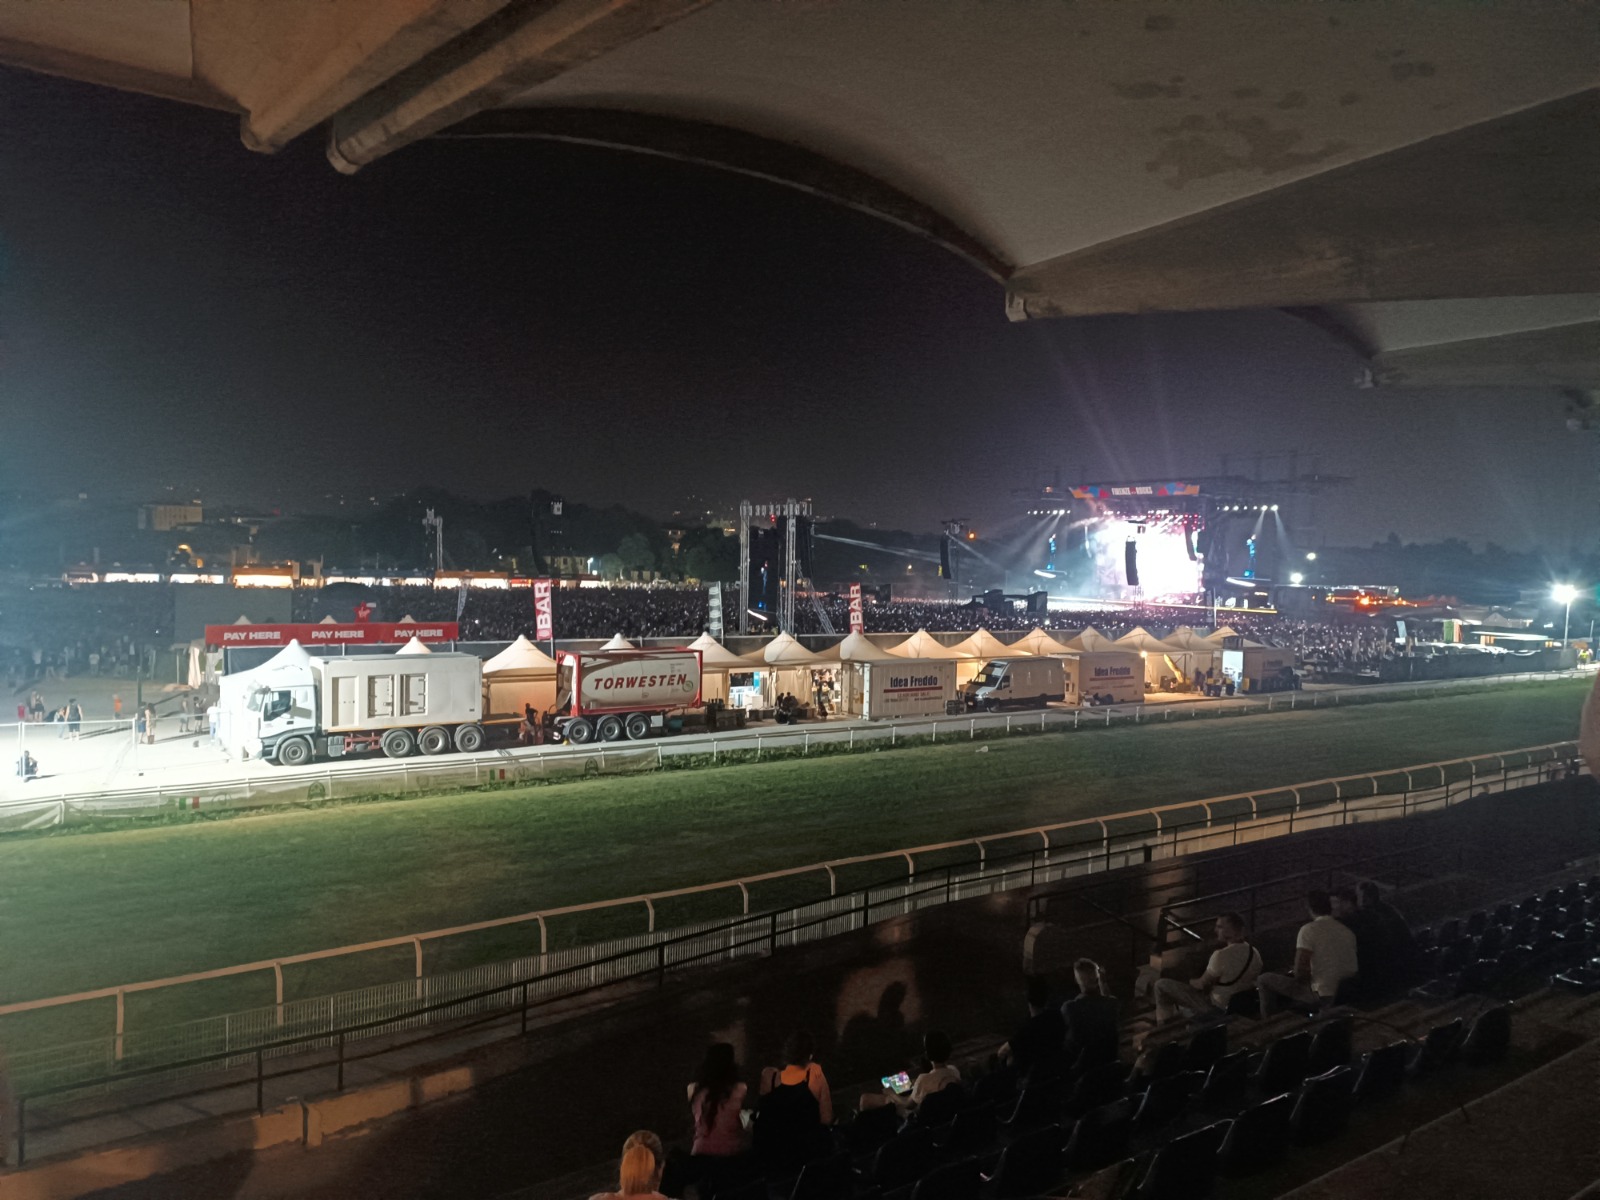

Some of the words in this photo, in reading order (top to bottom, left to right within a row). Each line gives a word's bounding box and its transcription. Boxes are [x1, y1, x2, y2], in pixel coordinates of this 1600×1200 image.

[534, 581, 551, 630] BAR
[850, 585, 862, 624] BAR
[224, 632, 246, 640] PAY
[248, 631, 280, 640] HERE
[312, 630, 333, 639] PAY
[334, 630, 364, 638] HERE
[394, 629, 414, 638] PAY
[416, 629, 443, 637] HERE
[594, 674, 687, 690] TORWESTEN
[890, 676, 908, 688] Idea
[910, 675, 938, 687] Freddo
